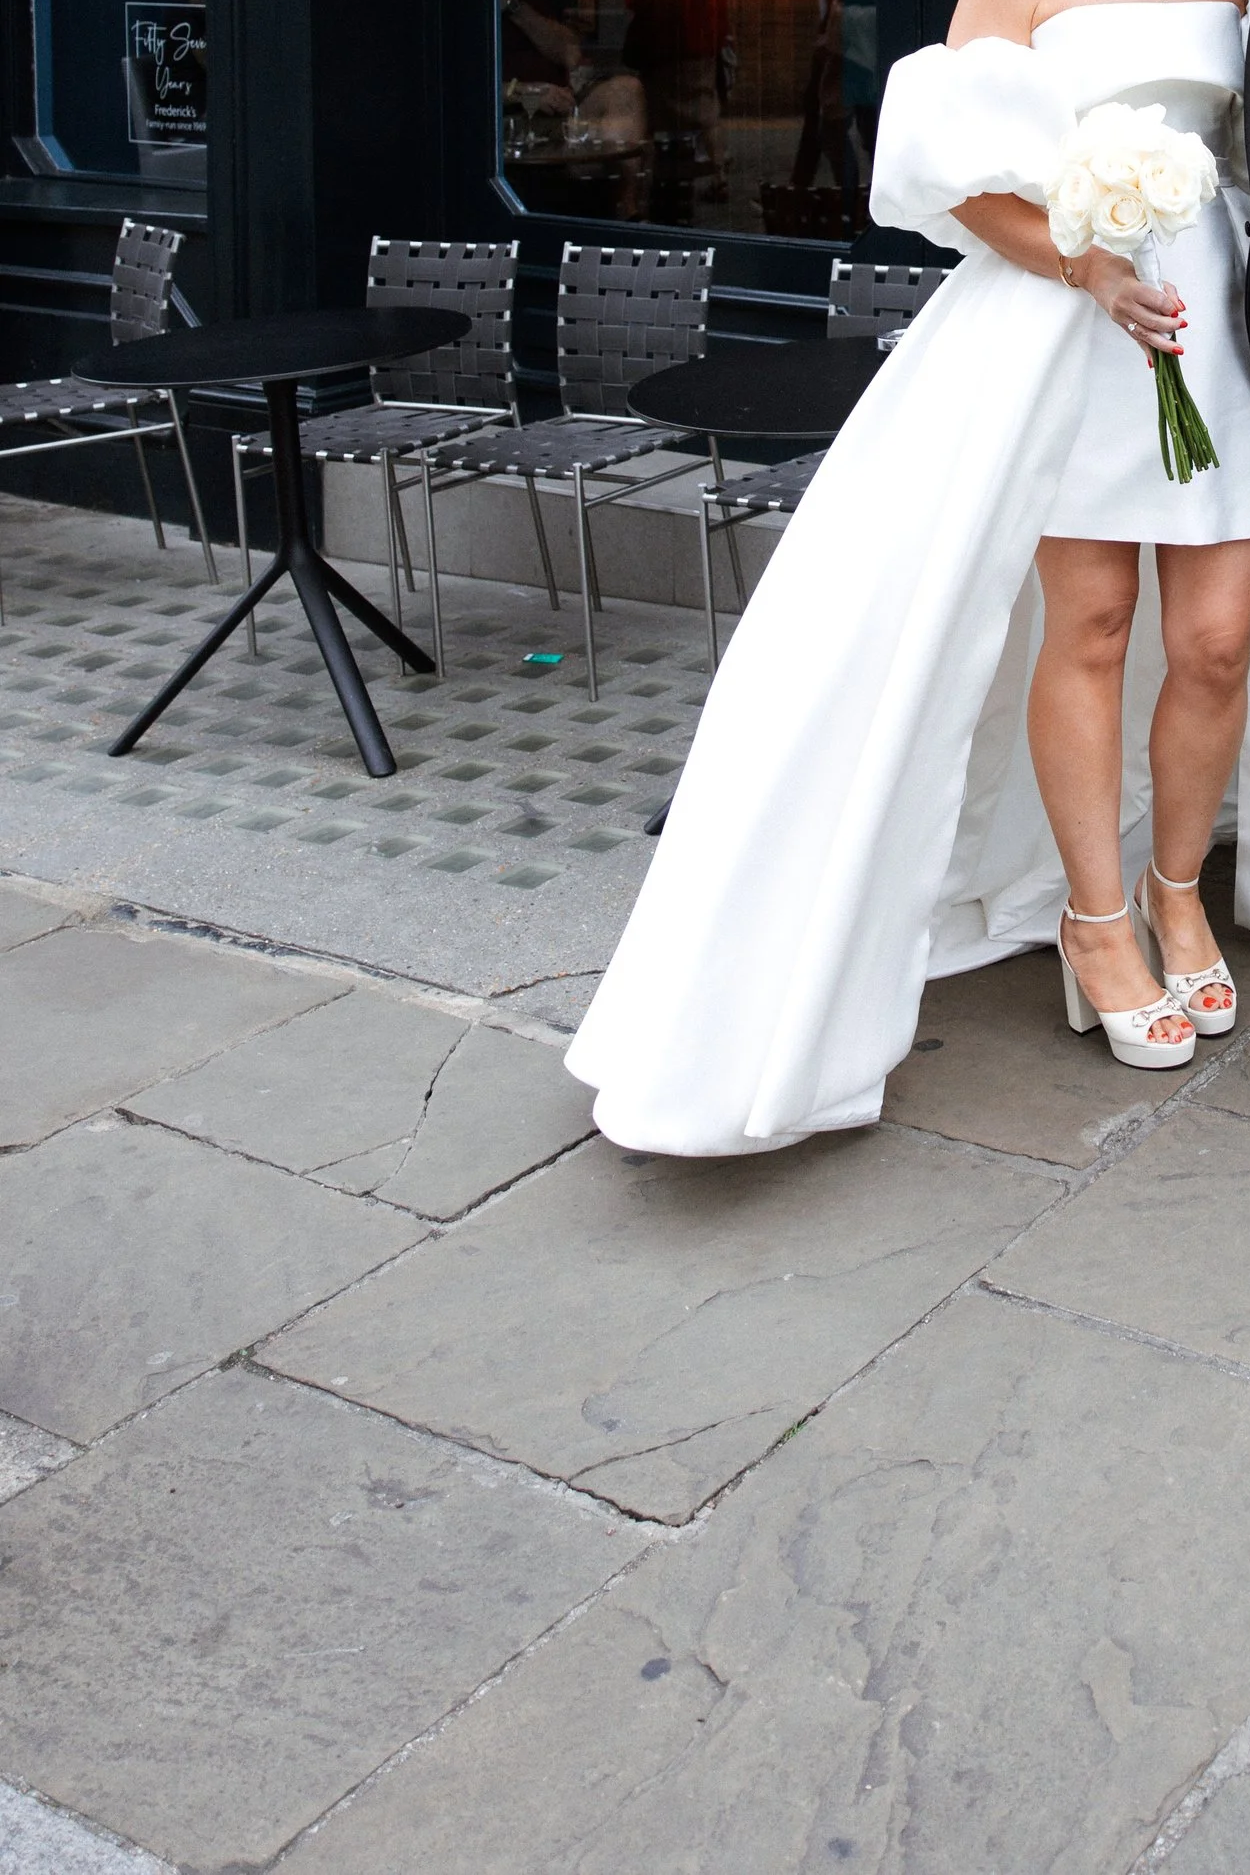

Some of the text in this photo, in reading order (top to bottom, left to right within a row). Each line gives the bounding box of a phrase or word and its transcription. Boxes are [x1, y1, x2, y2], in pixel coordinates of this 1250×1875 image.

[131, 20, 167, 65] Fifty
[155, 66, 192, 99] Years
[154, 104, 197, 118] Frederick's
